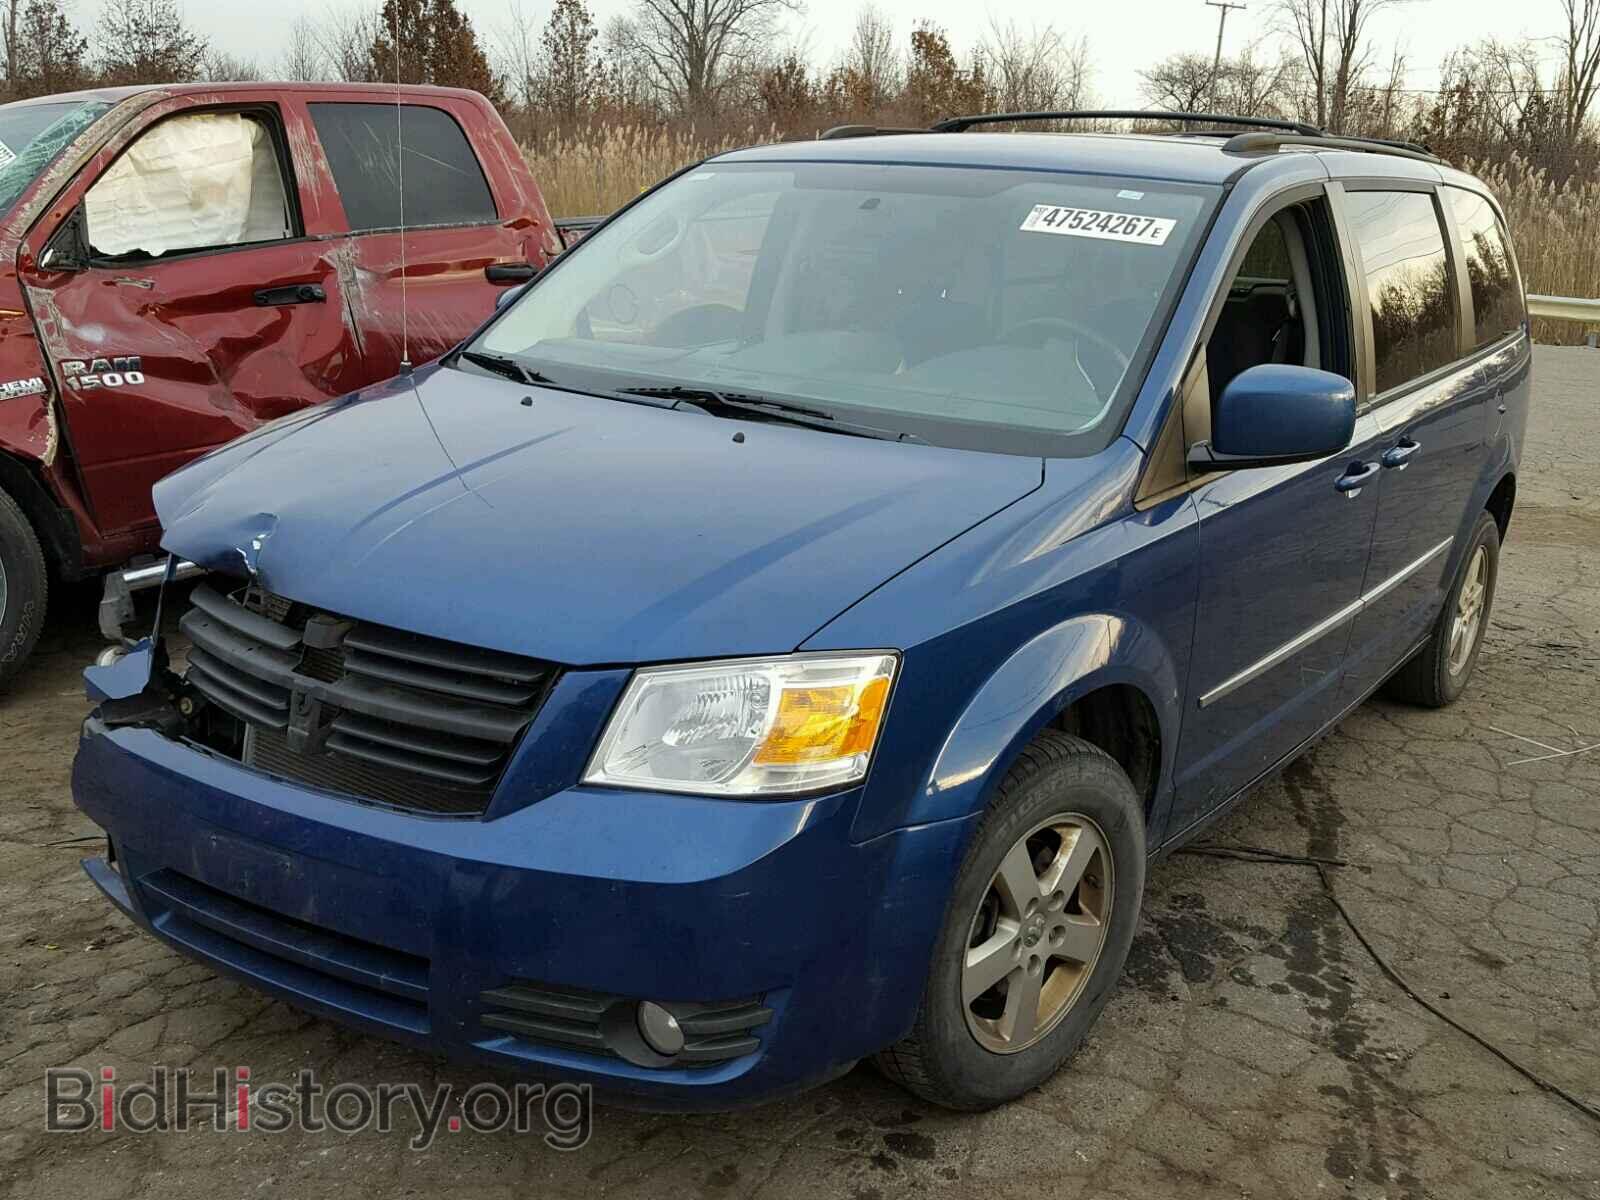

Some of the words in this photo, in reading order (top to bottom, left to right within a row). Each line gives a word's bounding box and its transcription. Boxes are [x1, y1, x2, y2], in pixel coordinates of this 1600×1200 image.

[1042, 207, 1155, 237] 47524267
[1150, 227, 1162, 239] E
[61, 356, 142, 376] RAM
[66, 370, 145, 391] 1500
